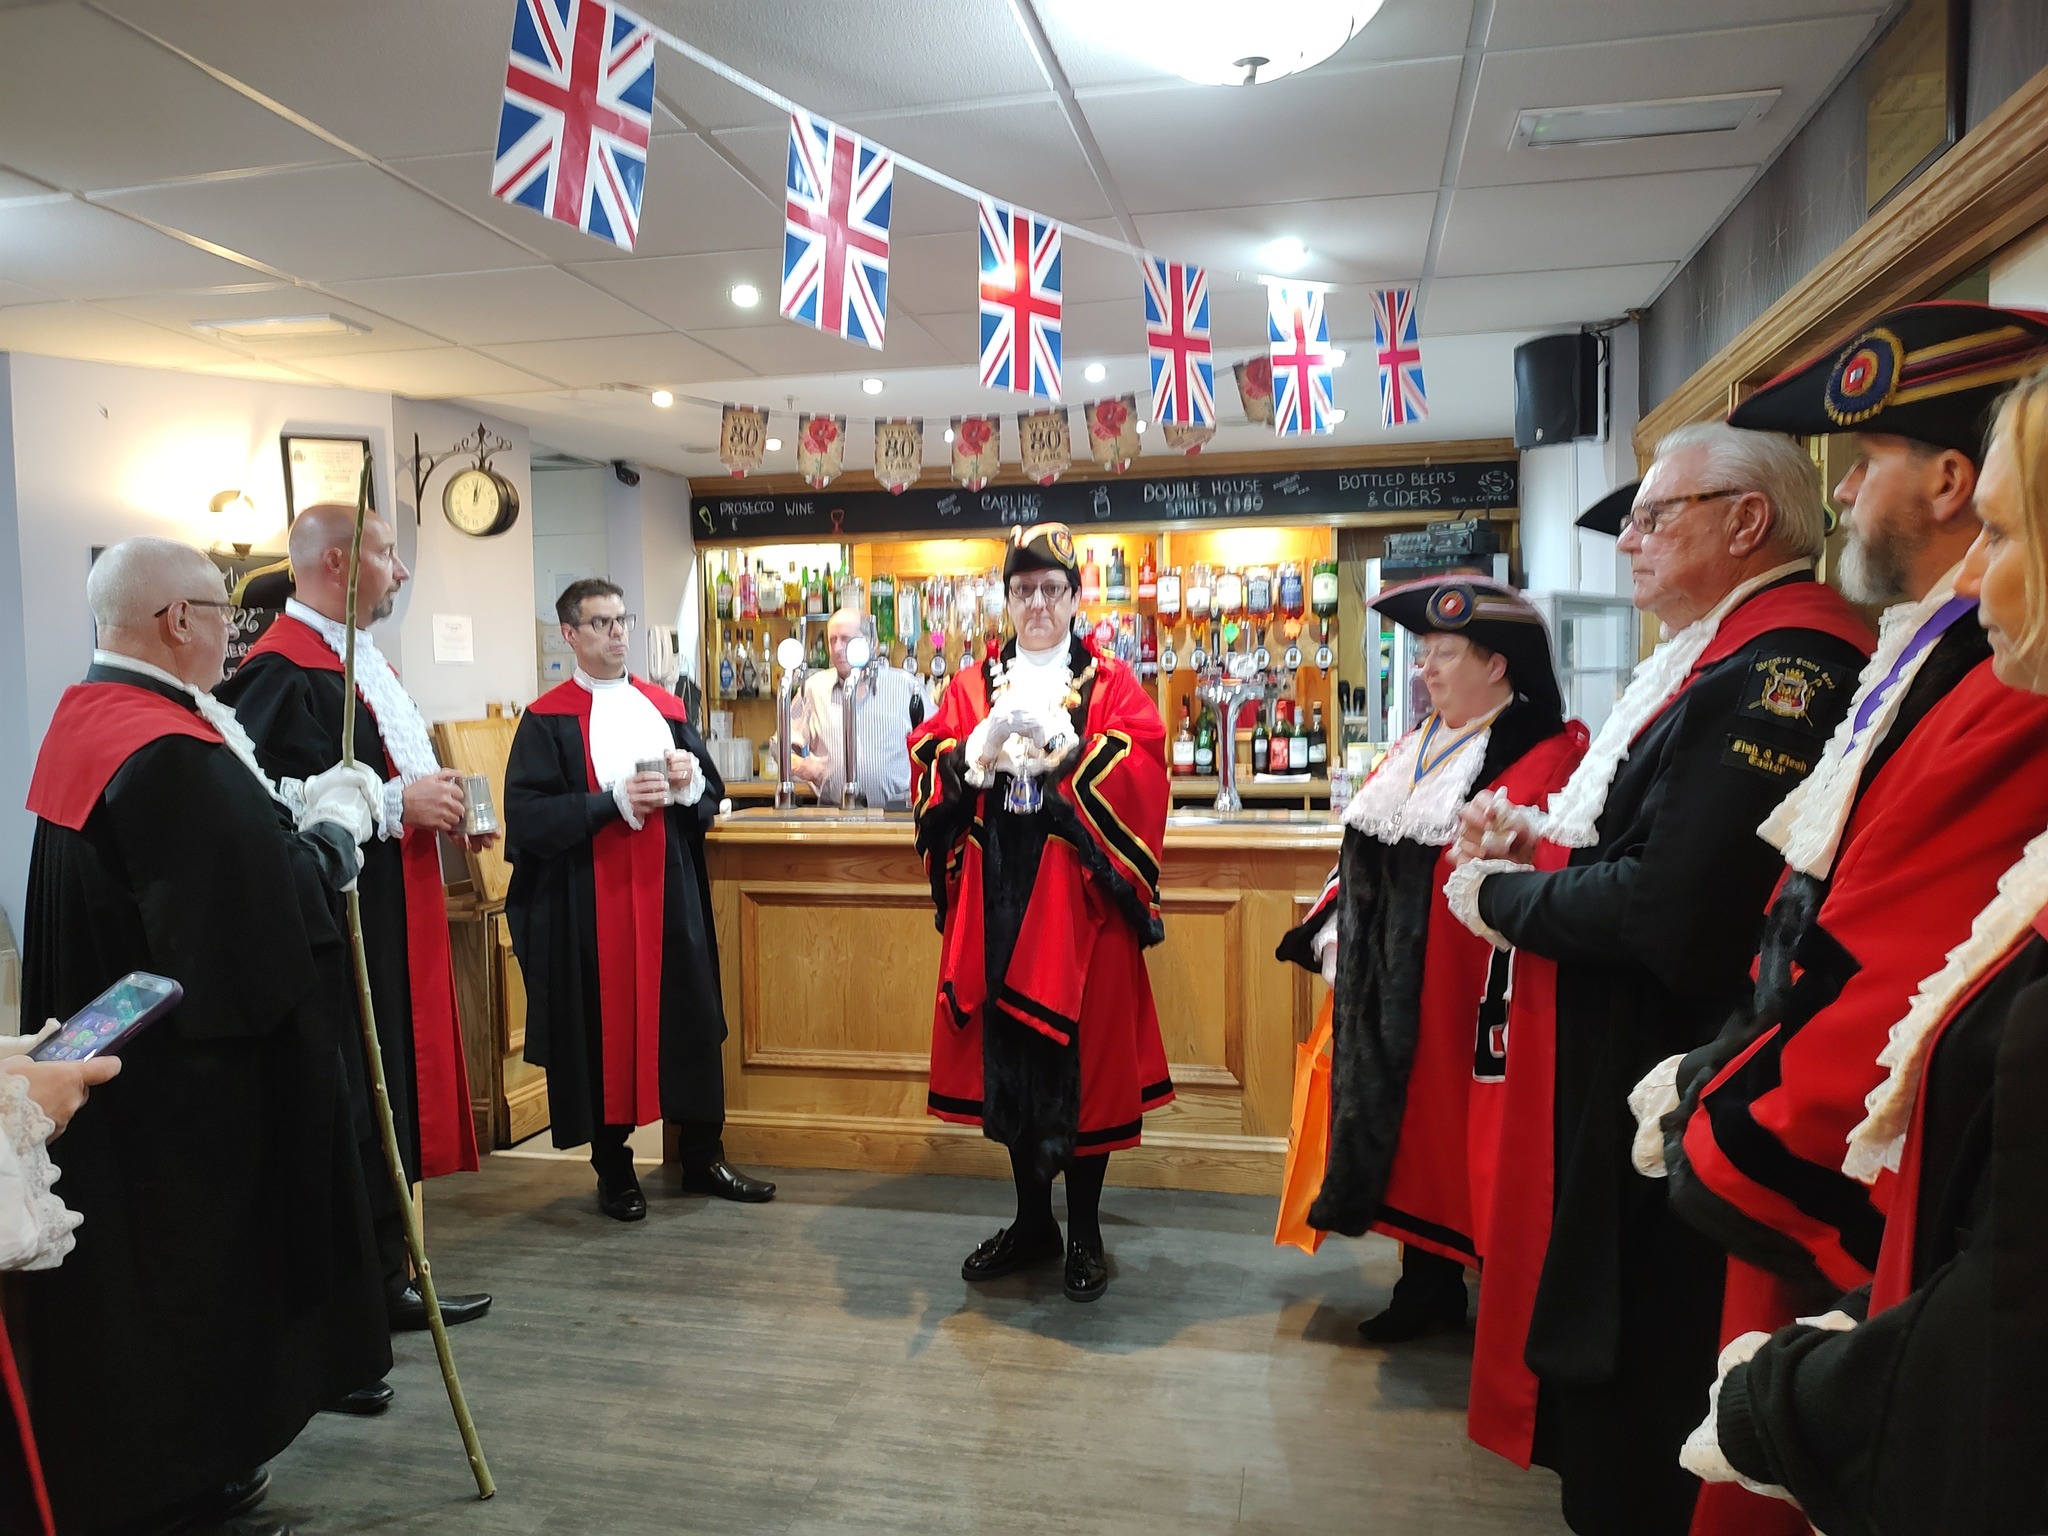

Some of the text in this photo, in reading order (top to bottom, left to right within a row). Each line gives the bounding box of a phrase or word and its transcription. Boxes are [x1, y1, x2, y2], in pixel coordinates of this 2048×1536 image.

[1042, 420, 1060, 429] DAY
[730, 424, 759, 447] 80
[1031, 427, 1062, 451] 80
[884, 438, 914, 460] 80
[1032, 451, 1062, 463] YEARS
[885, 461, 913, 470] YEARS
[1143, 480, 1201, 503] DOUBLE
[1212, 479, 1263, 497] HOUSE
[1339, 471, 1456, 491] BOTTLED BEERS
[981, 493, 1041, 510] CARLING
[1383, 487, 1441, 507] CIDERS
[720, 501, 815, 516] PROSECCO WINE
[1166, 497, 1217, 518] SPIRITS
